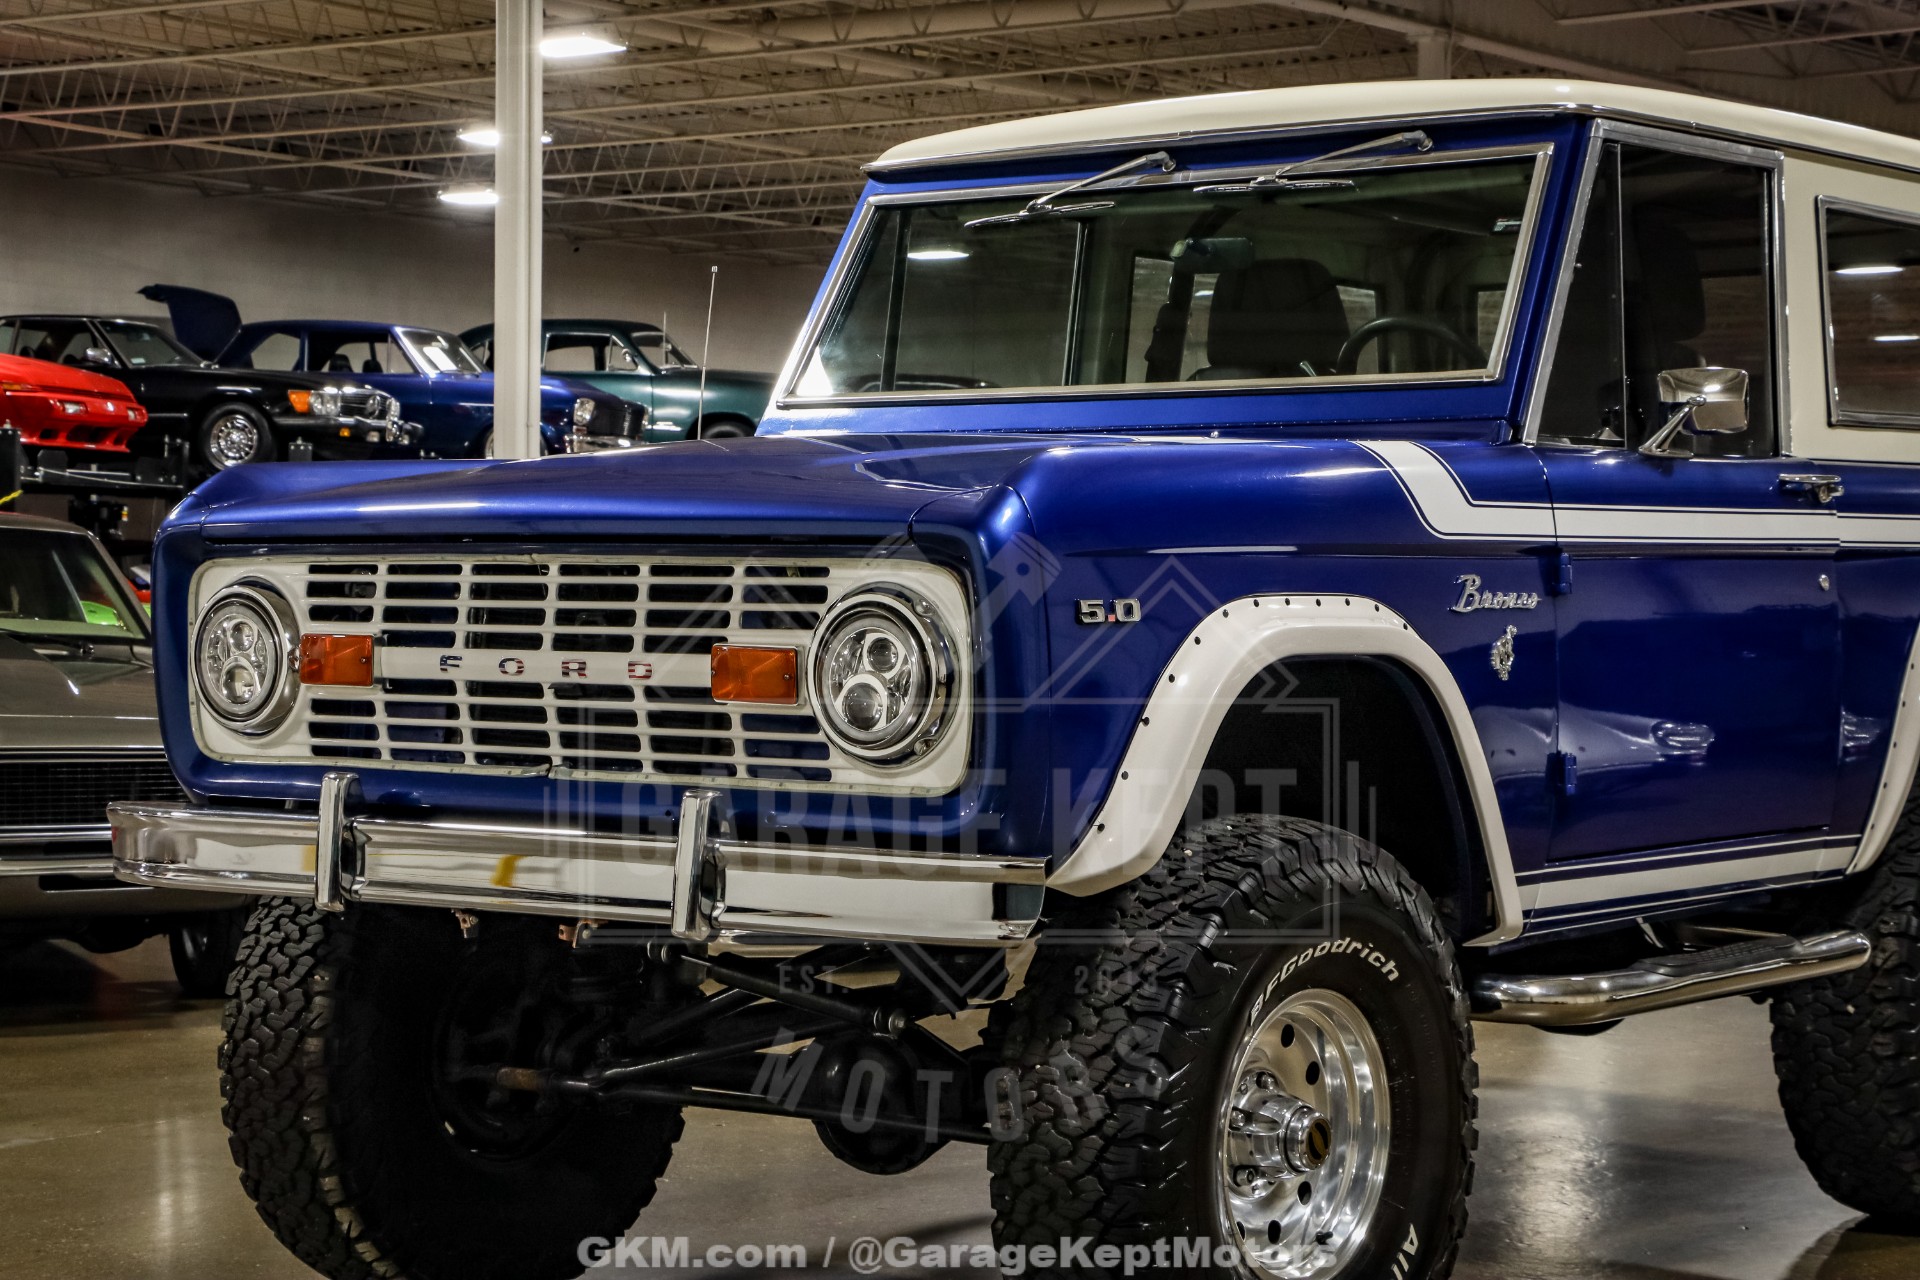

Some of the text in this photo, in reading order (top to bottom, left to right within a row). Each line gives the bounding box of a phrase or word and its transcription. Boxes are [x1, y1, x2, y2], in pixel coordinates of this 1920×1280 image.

[1447, 574, 1541, 613] Bronco
[1076, 598, 1141, 624] 5.0
[439, 654, 653, 680] FORD
[1250, 937, 1400, 1027] BFGoodrich
